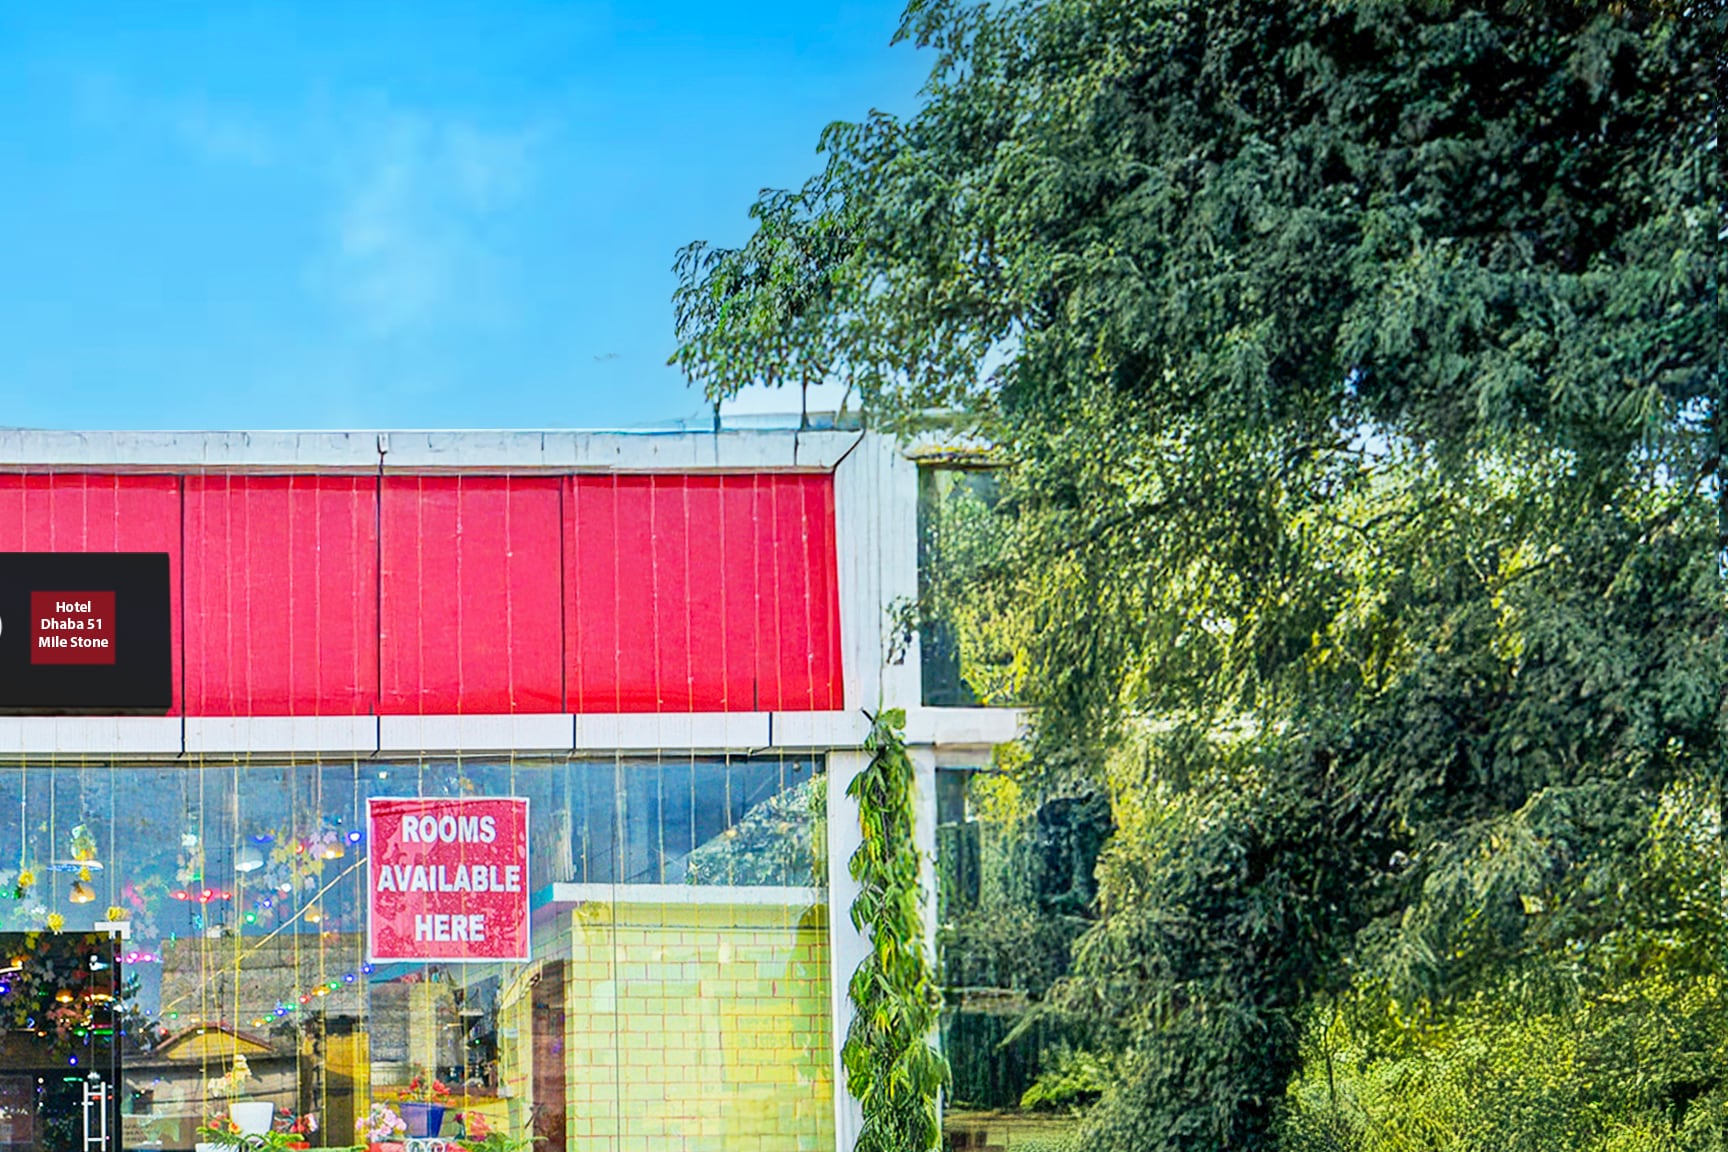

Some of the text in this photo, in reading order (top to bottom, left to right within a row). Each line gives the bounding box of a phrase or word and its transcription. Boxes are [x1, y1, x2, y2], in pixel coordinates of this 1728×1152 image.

[56, 600, 92, 613] Hotel
[40, 617, 102, 630] Dhaba 51
[38, 635, 109, 648] Mile Stone
[402, 815, 497, 843] ROOMS
[377, 864, 521, 892] AVAILABLE
[415, 914, 485, 942] HERE
